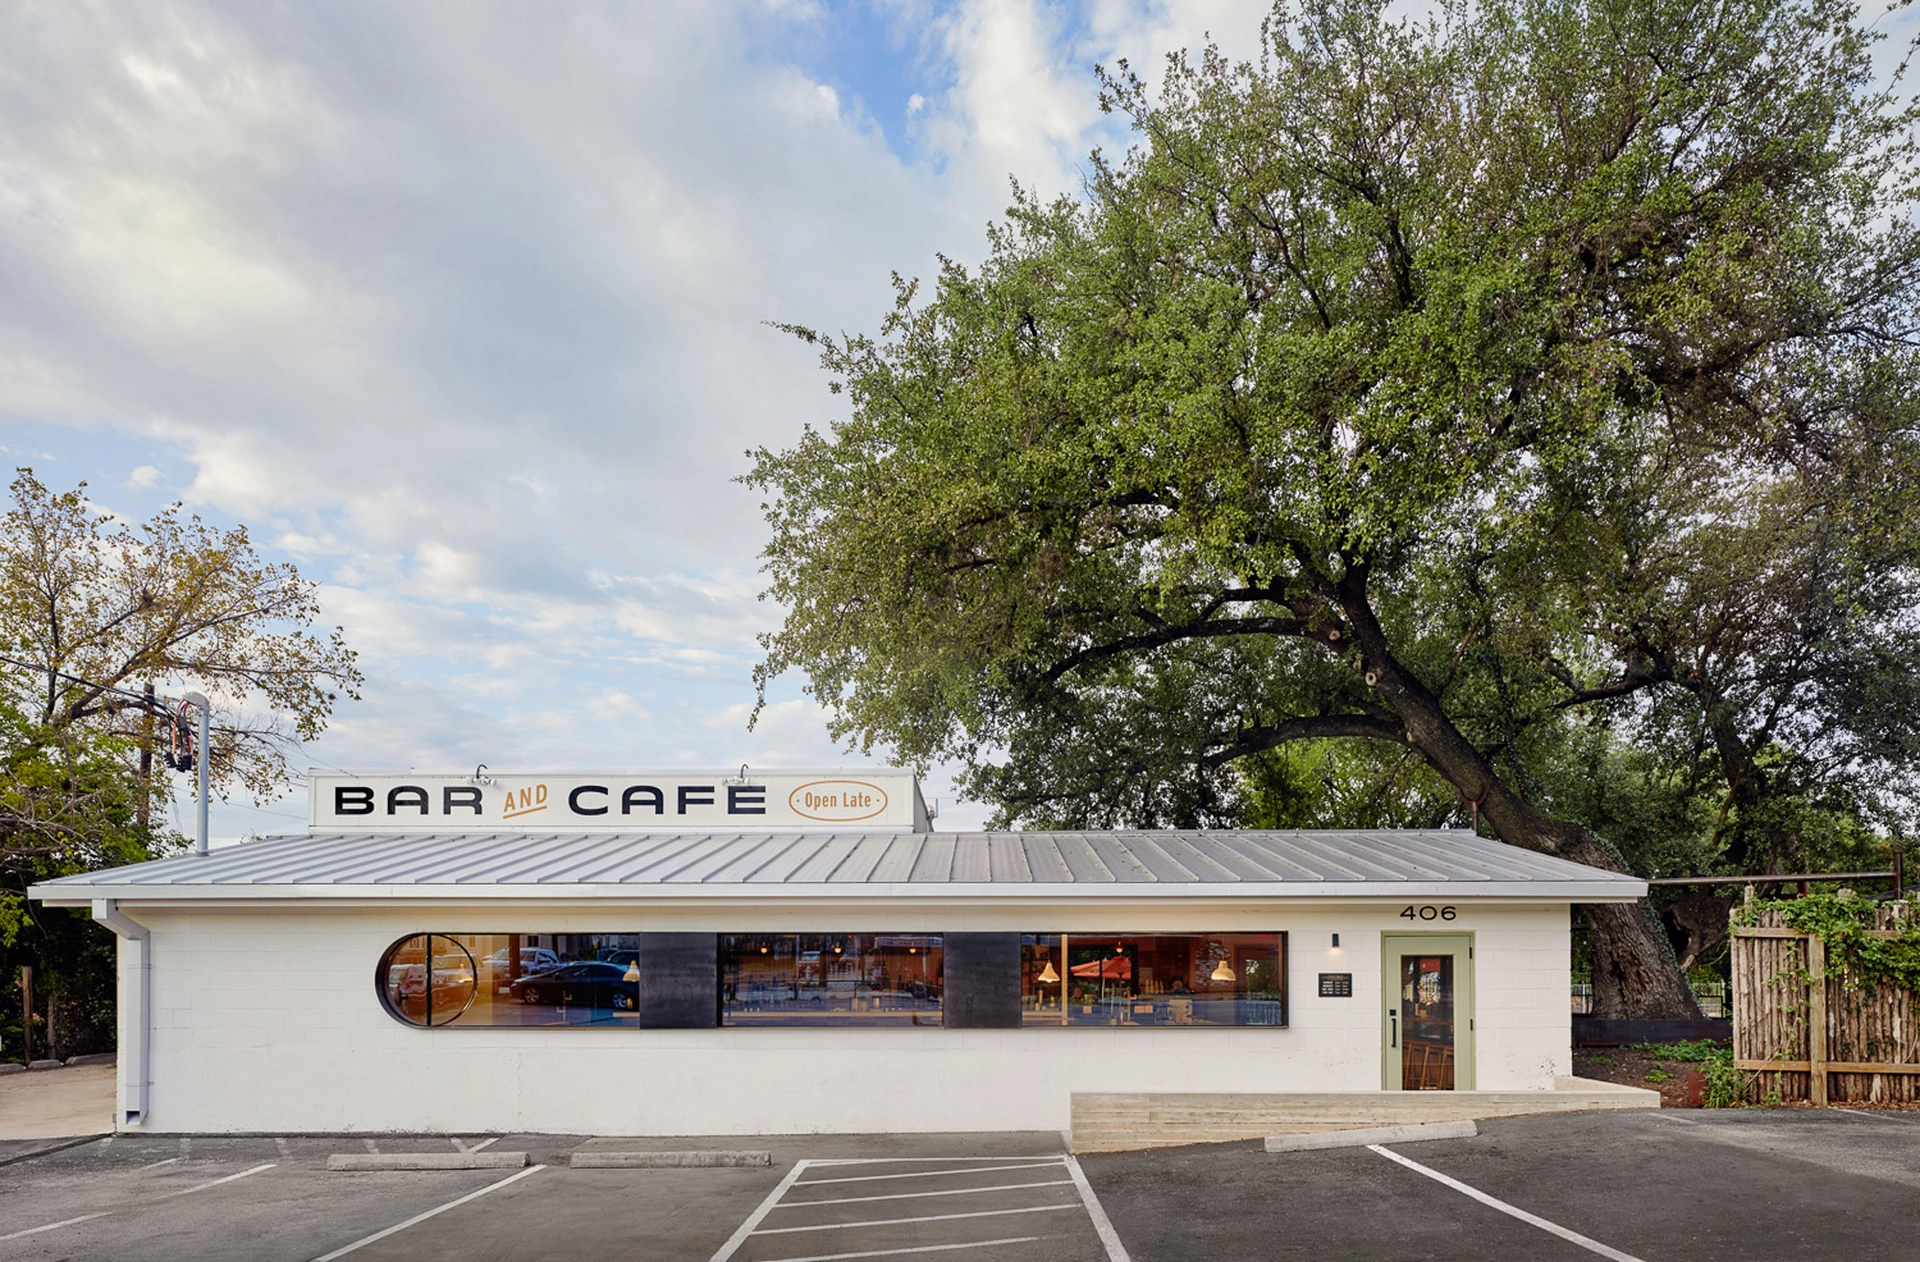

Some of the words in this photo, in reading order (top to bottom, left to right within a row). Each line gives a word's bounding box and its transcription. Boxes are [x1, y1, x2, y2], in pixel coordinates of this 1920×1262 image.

[334, 785, 483, 815] BAR
[503, 784, 548, 813] AND
[568, 785, 766, 816] CAFE
[804, 792, 837, 811] Open
[843, 792, 871, 807] Late
[1400, 905, 1457, 921] 406
